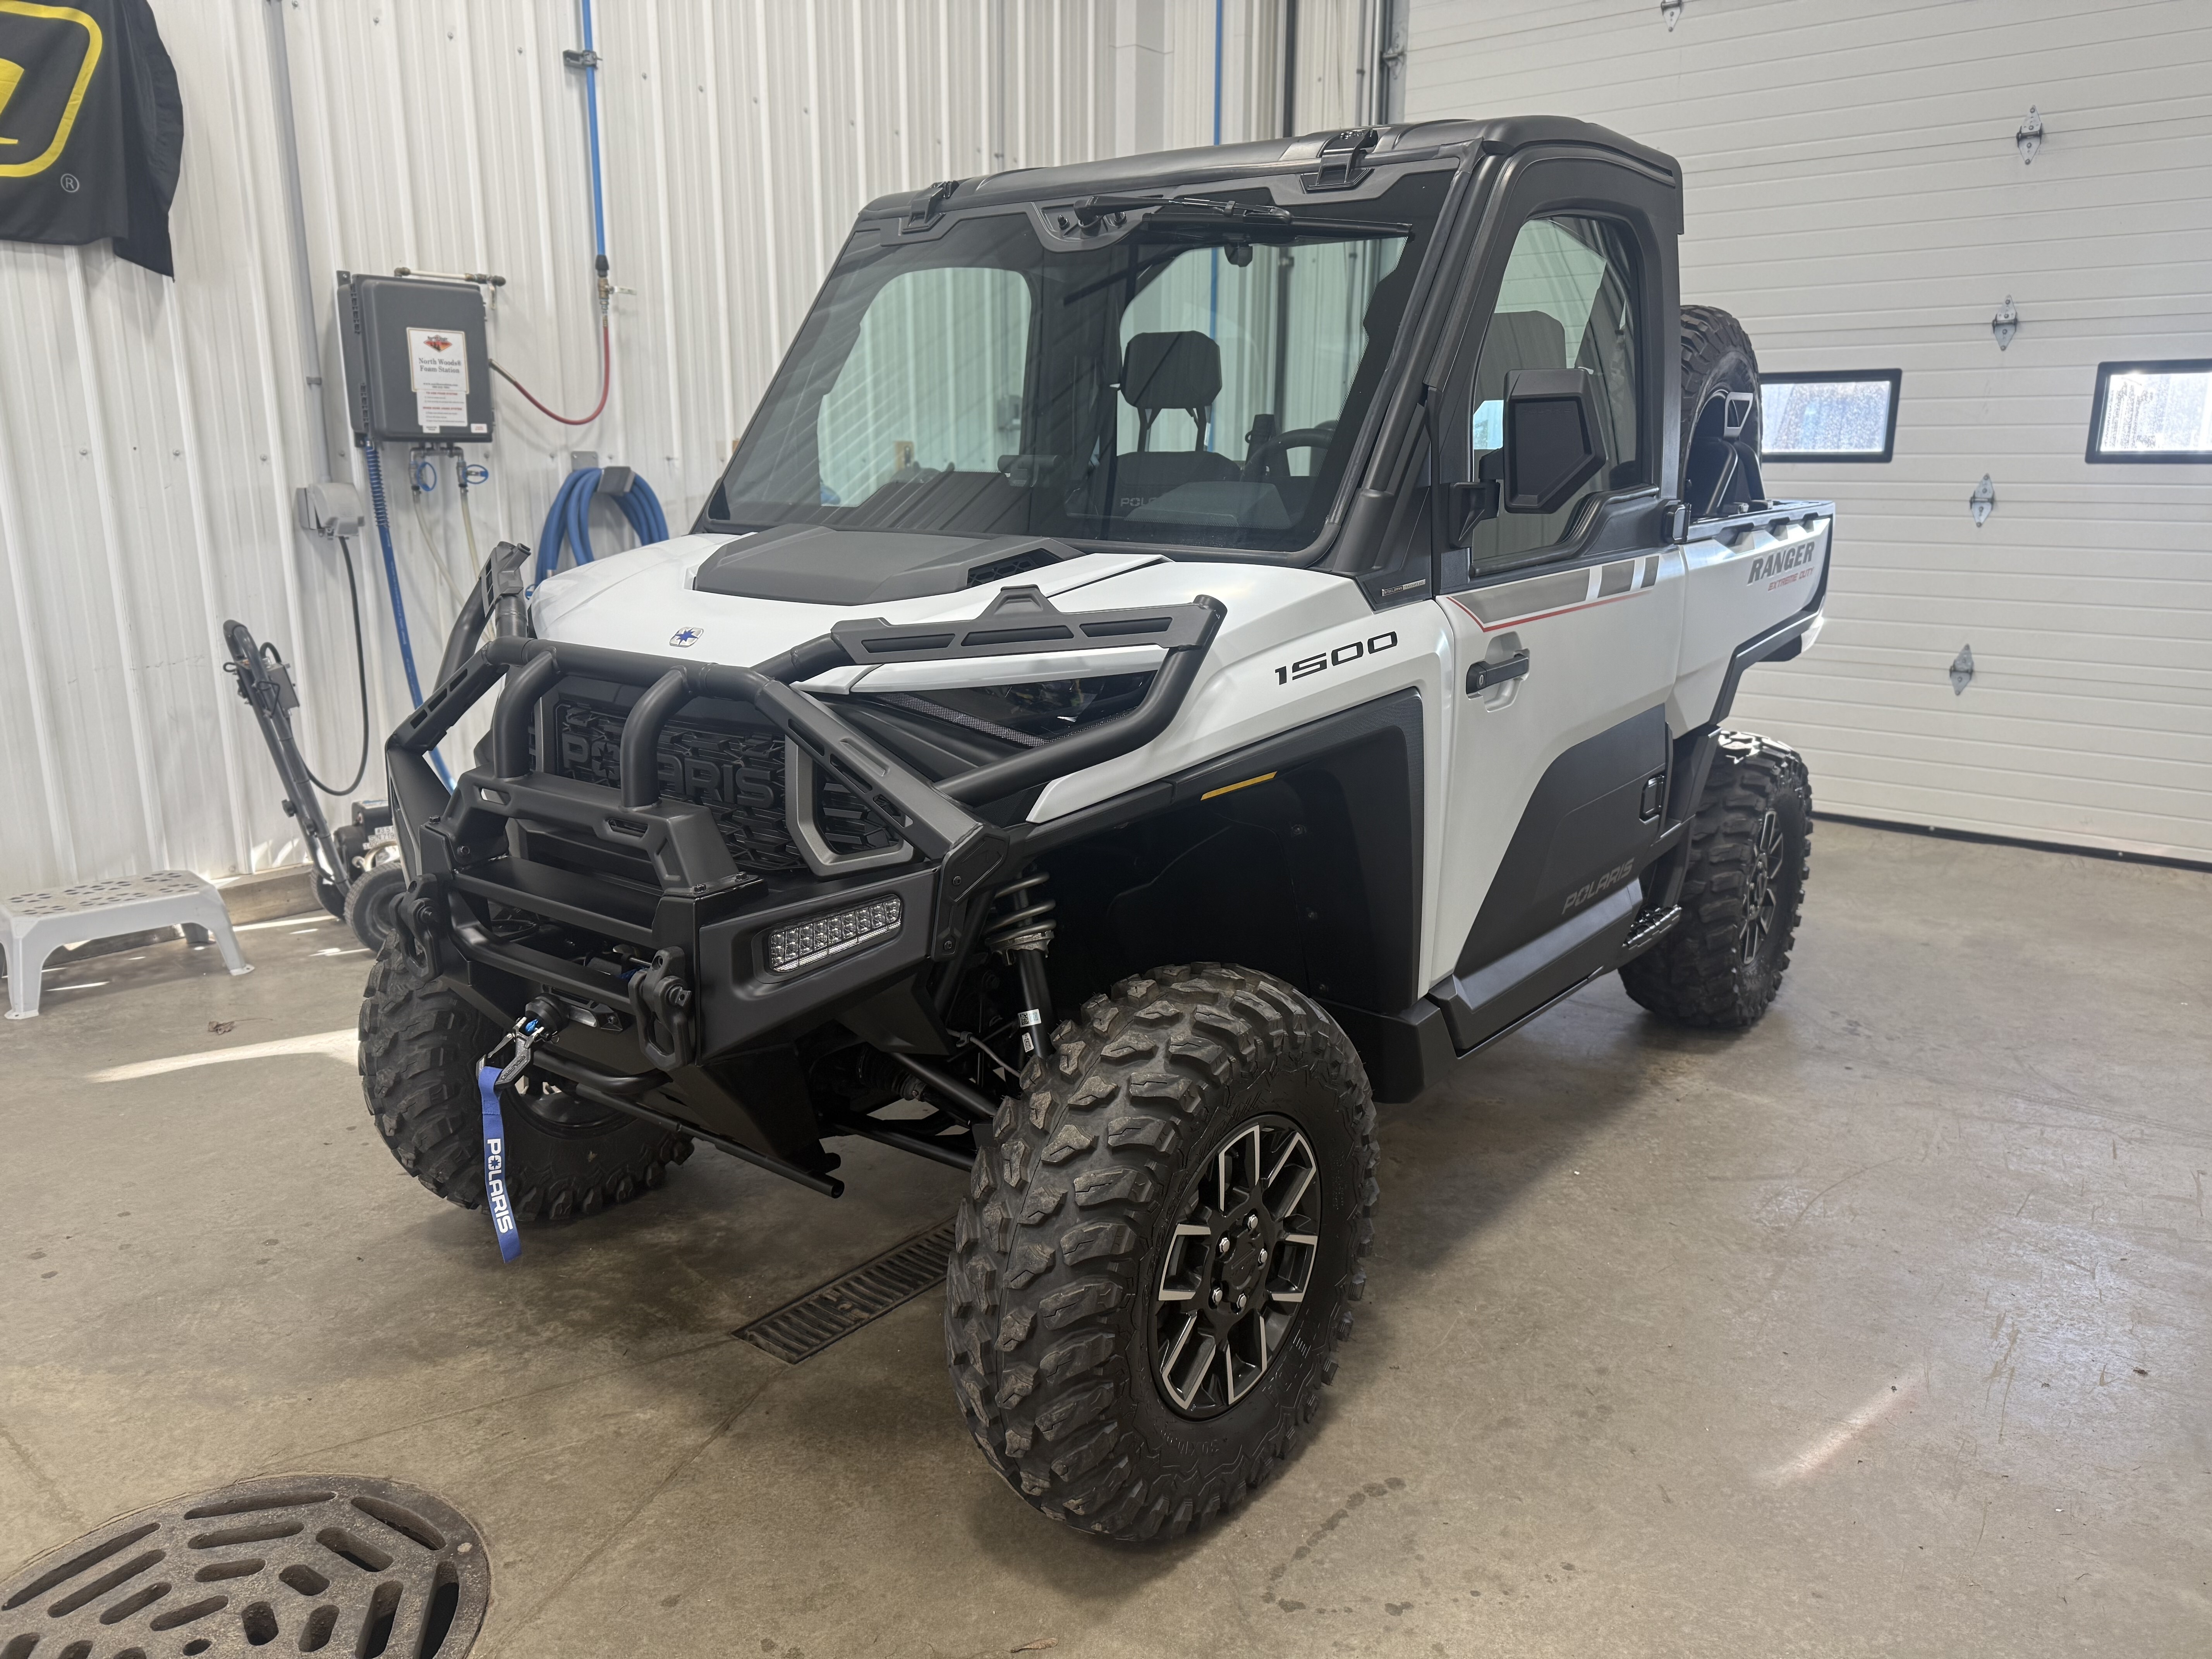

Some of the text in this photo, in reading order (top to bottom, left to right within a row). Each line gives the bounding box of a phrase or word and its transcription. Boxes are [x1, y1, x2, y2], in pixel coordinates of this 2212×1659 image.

[1747, 541, 1815, 584] RANGER
[1768, 567, 1814, 591] EXTREME DUTY
[1274, 631, 1398, 685] 1500
[1561, 857, 1636, 915] POLARIS
[487, 1138, 513, 1233] POLARIS
